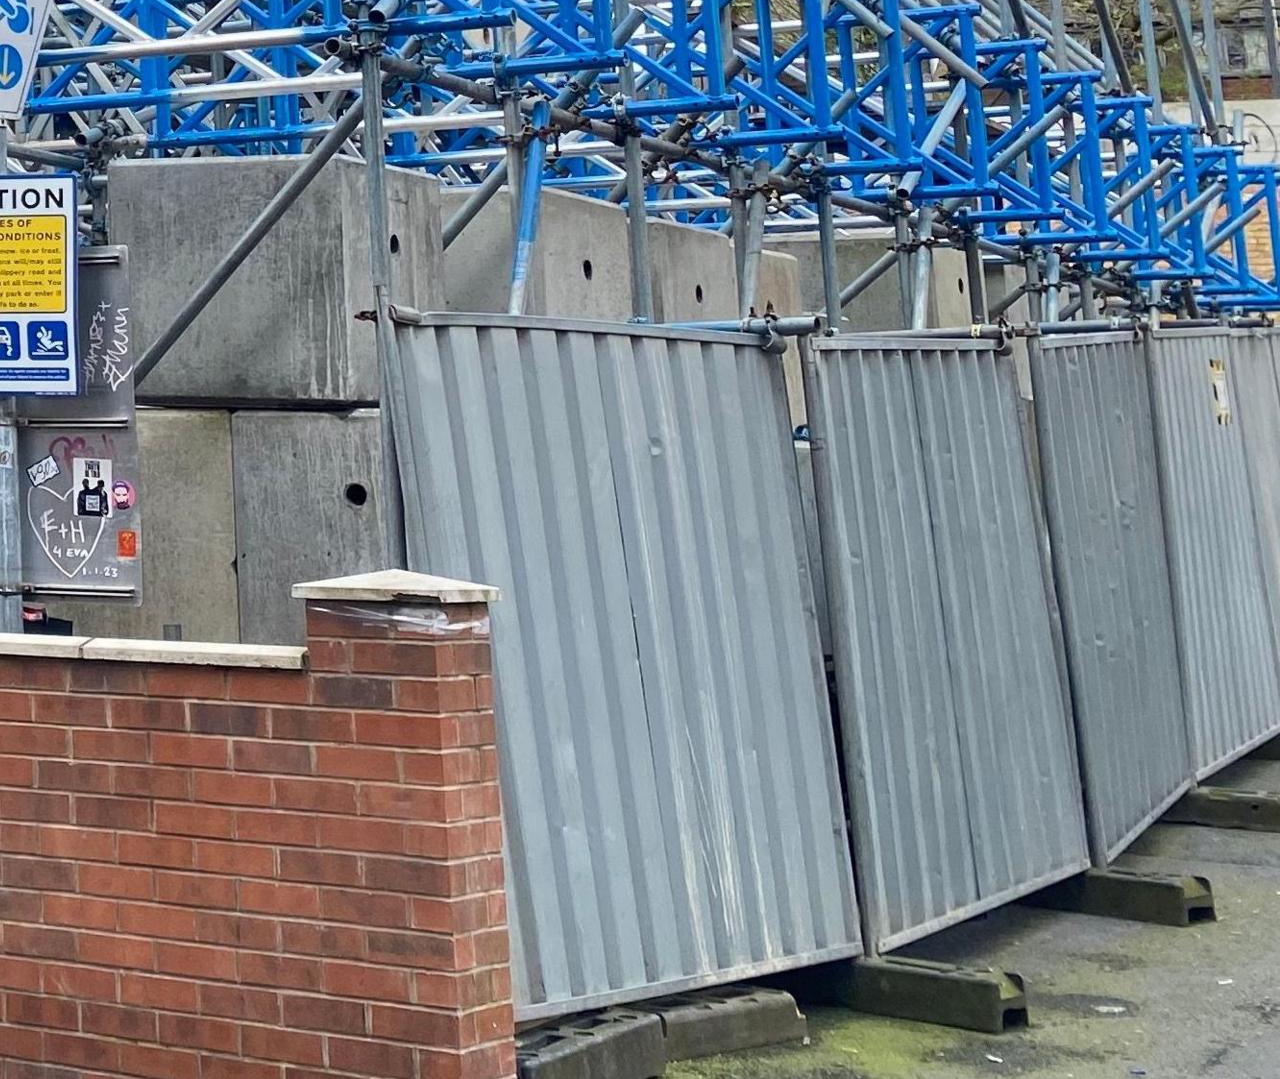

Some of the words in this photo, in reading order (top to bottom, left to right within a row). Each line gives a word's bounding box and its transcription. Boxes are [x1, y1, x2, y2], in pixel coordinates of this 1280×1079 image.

[17, 219, 32, 228] OF
[53, 545, 62, 558] 4
[66, 548, 90, 559] EVA
